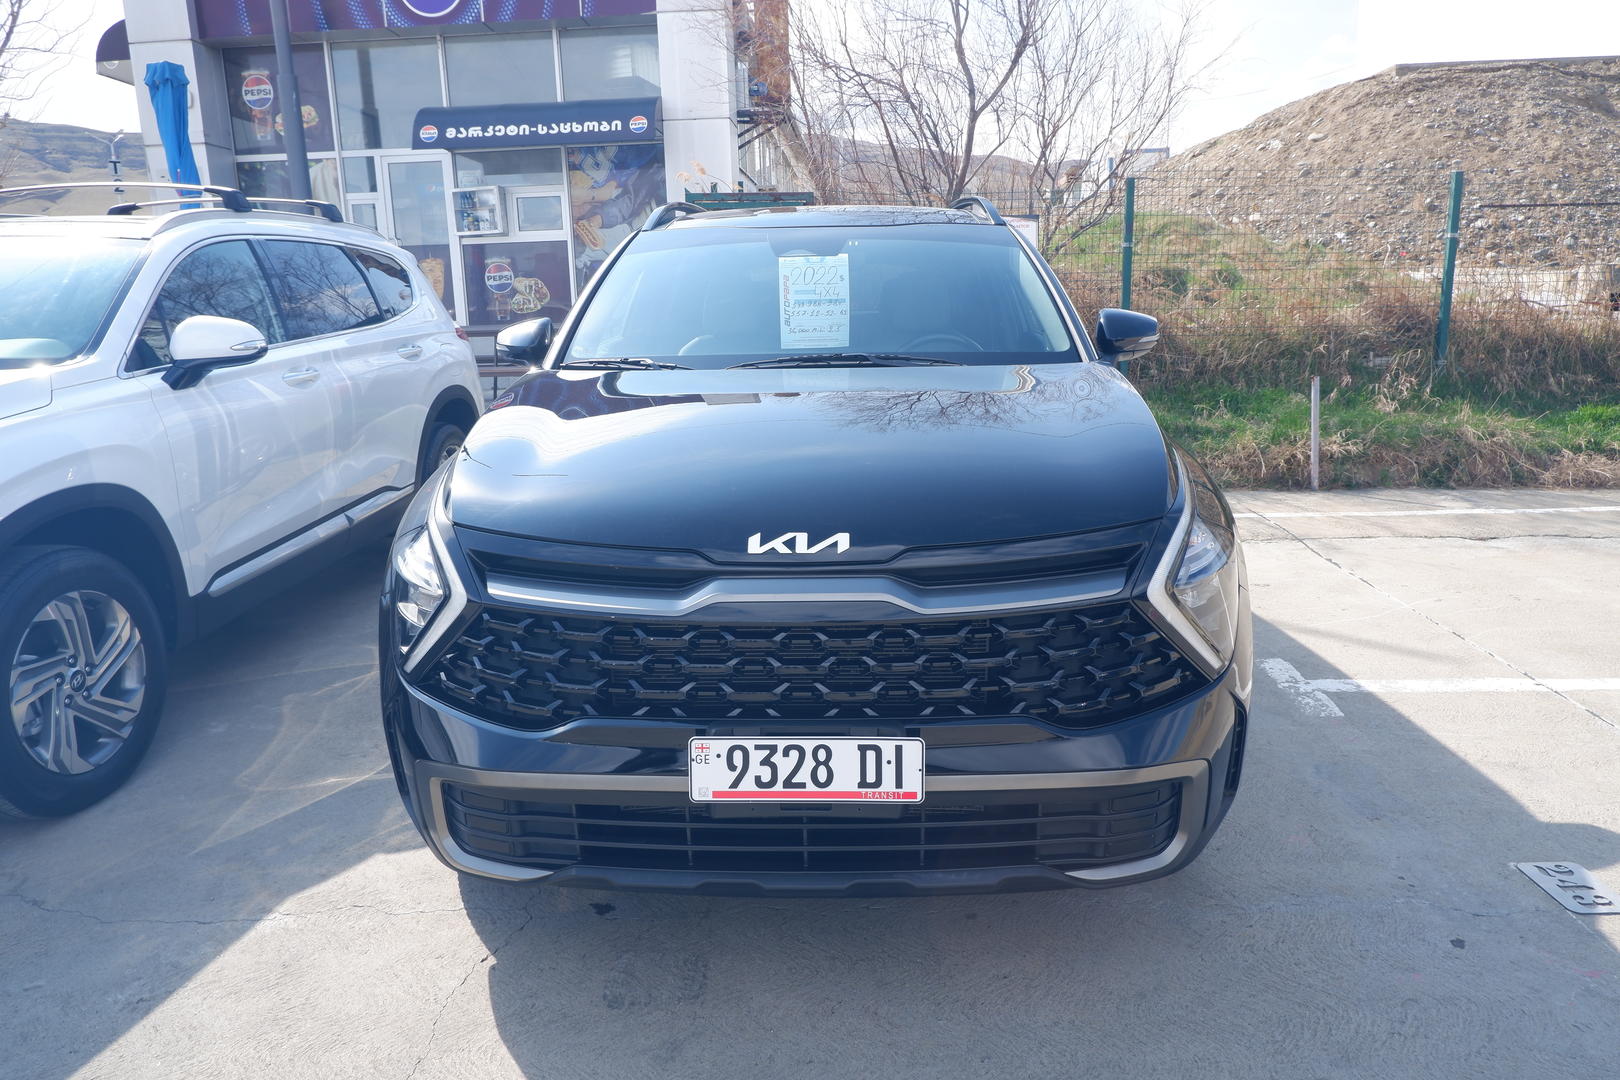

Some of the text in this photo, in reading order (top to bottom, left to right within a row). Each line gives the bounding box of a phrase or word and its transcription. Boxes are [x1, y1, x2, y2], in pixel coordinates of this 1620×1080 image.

[244, 88, 271, 97] PEPSI
[445, 119, 622, 139] მარკეტი-საცხობი
[486, 274, 512, 282] PEPSI
[790, 265, 840, 286] 2022
[747, 532, 851, 554] KIA
[695, 754, 710, 765] GE
[725, 743, 834, 789] 9328
[860, 791, 905, 799] TRANSIT
